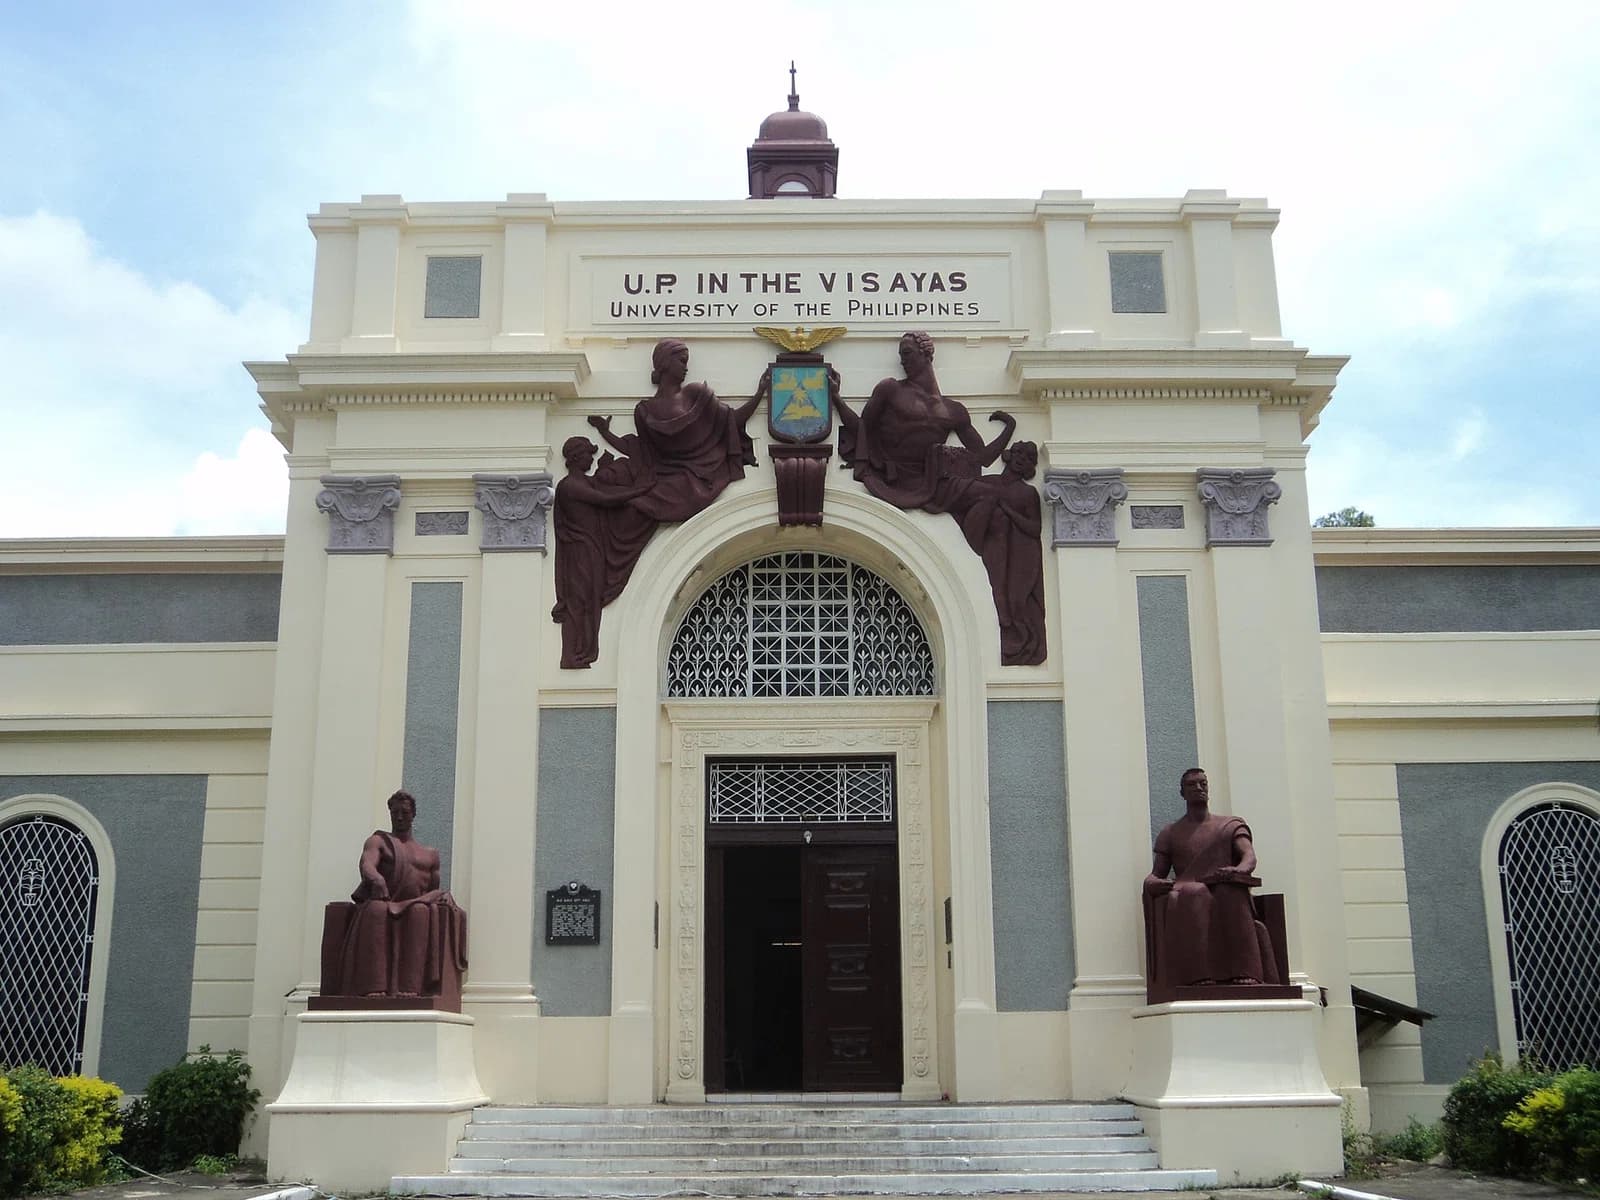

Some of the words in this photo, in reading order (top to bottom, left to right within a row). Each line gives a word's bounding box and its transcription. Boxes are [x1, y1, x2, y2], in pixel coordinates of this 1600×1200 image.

[697, 272, 729, 295] IN
[739, 272, 802, 294] THE
[818, 271, 968, 293] VISAYAS
[610, 300, 739, 318] UNIVERSITY
[753, 303, 779, 317] OF
[793, 302, 832, 317] THE
[848, 299, 980, 317] PHILIPPINES
